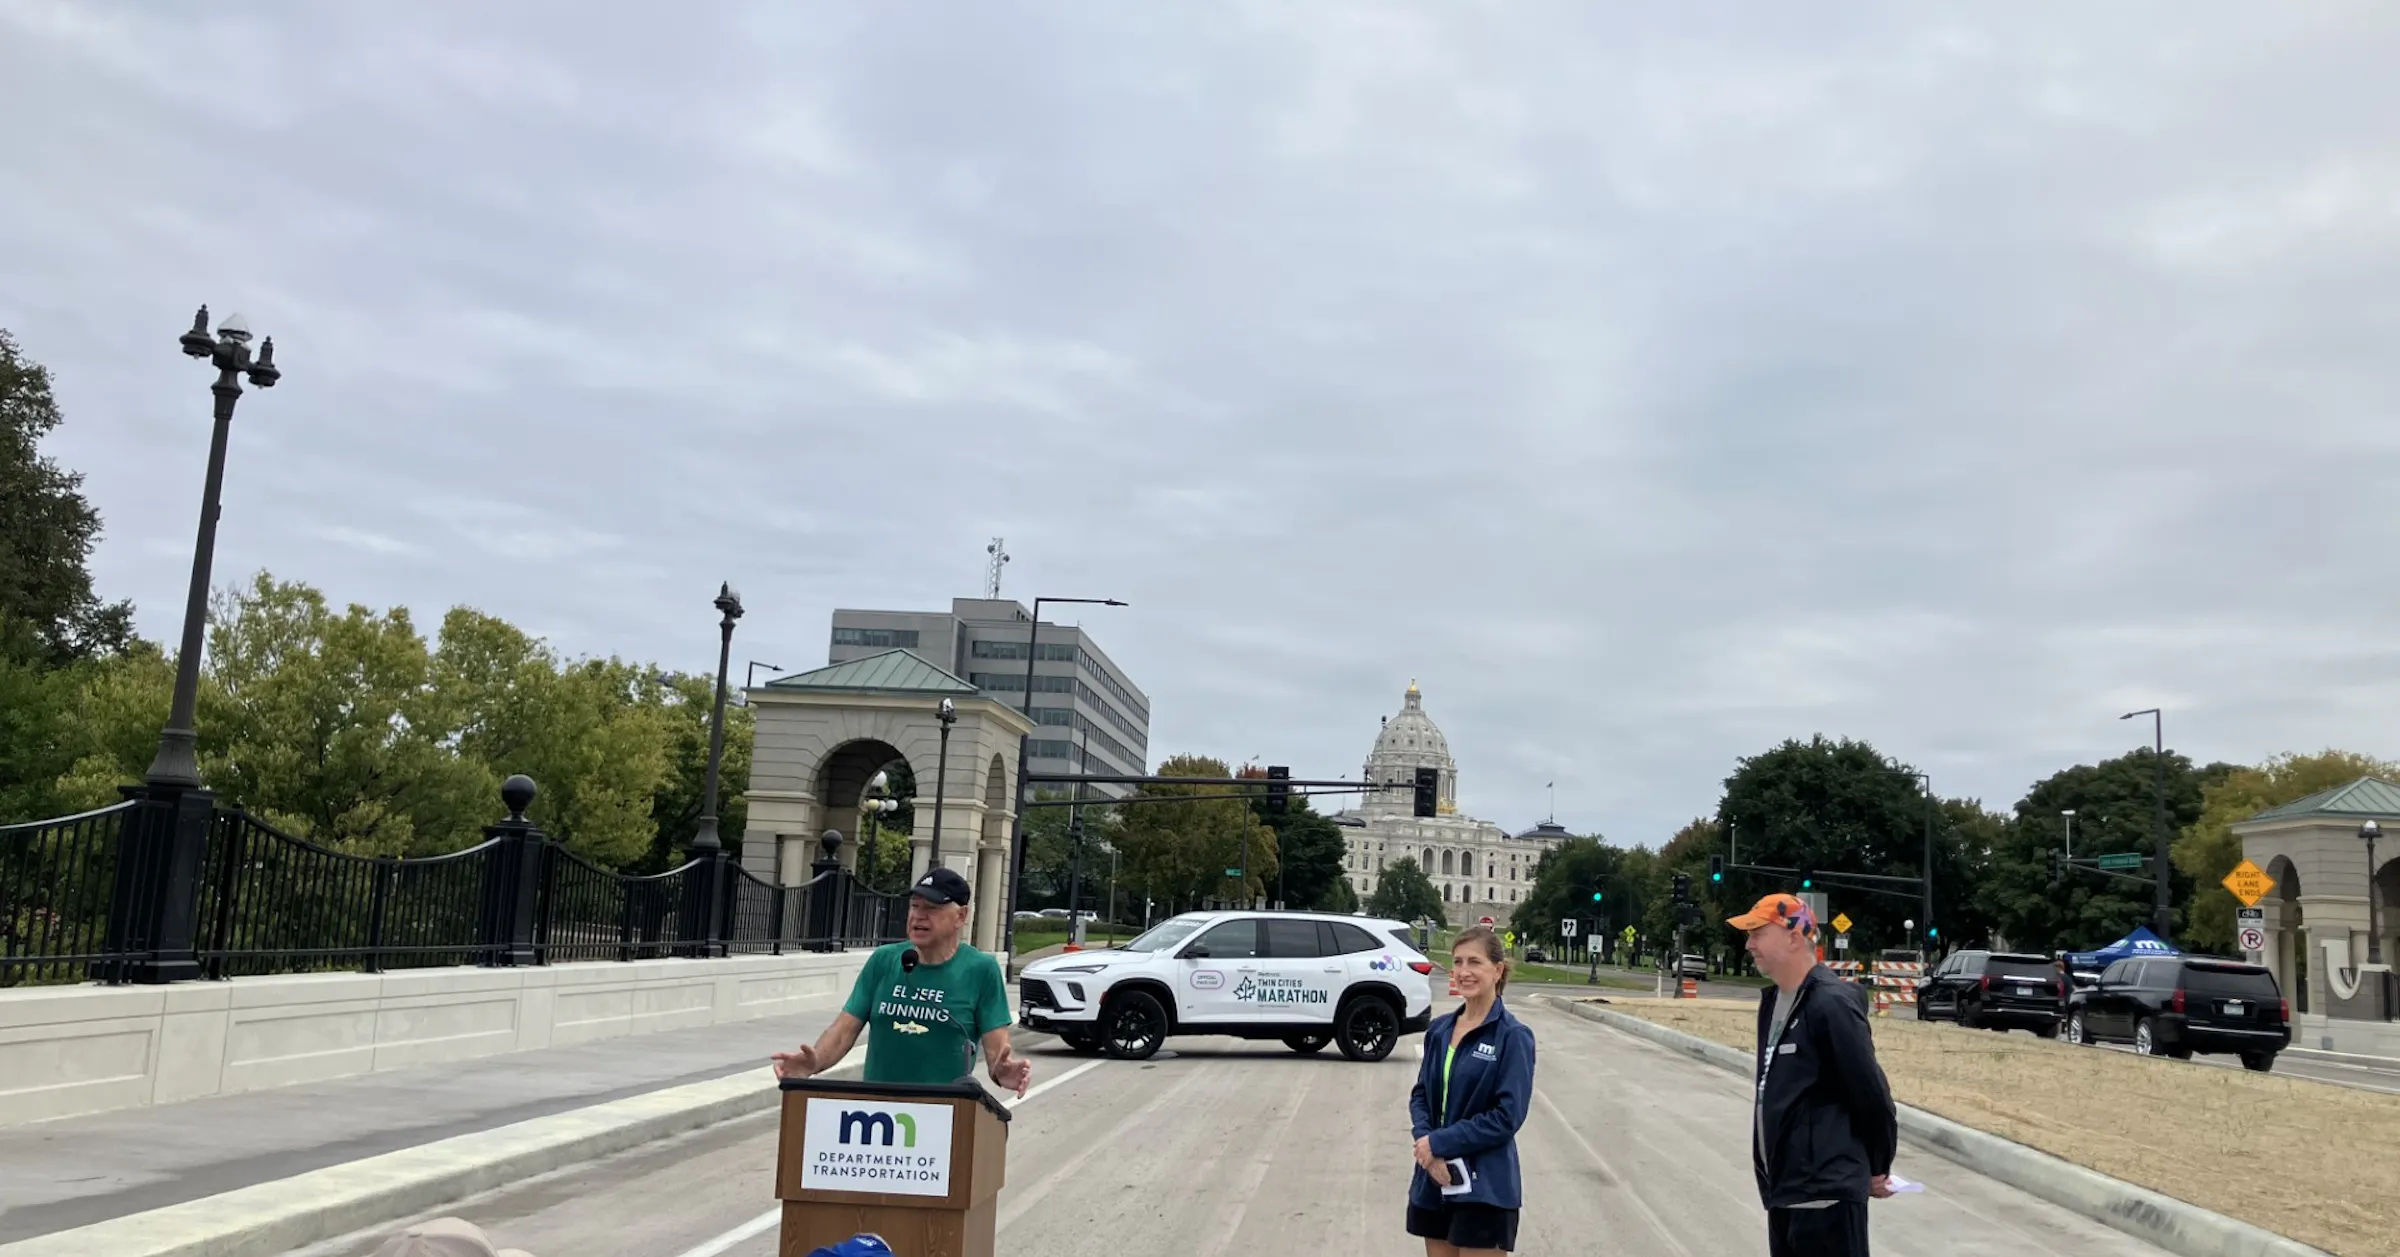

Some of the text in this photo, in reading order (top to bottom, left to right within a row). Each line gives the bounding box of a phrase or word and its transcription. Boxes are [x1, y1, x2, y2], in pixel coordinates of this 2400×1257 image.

[1257, 979, 1303, 988] TWIN CITIES
[892, 984, 945, 1003] EL JEFE
[1257, 988, 1328, 1004] MARATHON
[878, 1001, 949, 1023] RUNNING
[838, 1110, 917, 1148] mn
[819, 1151, 937, 1167] DEPARTMENT OF
[812, 1164, 940, 1181] TRANSPORTATION
